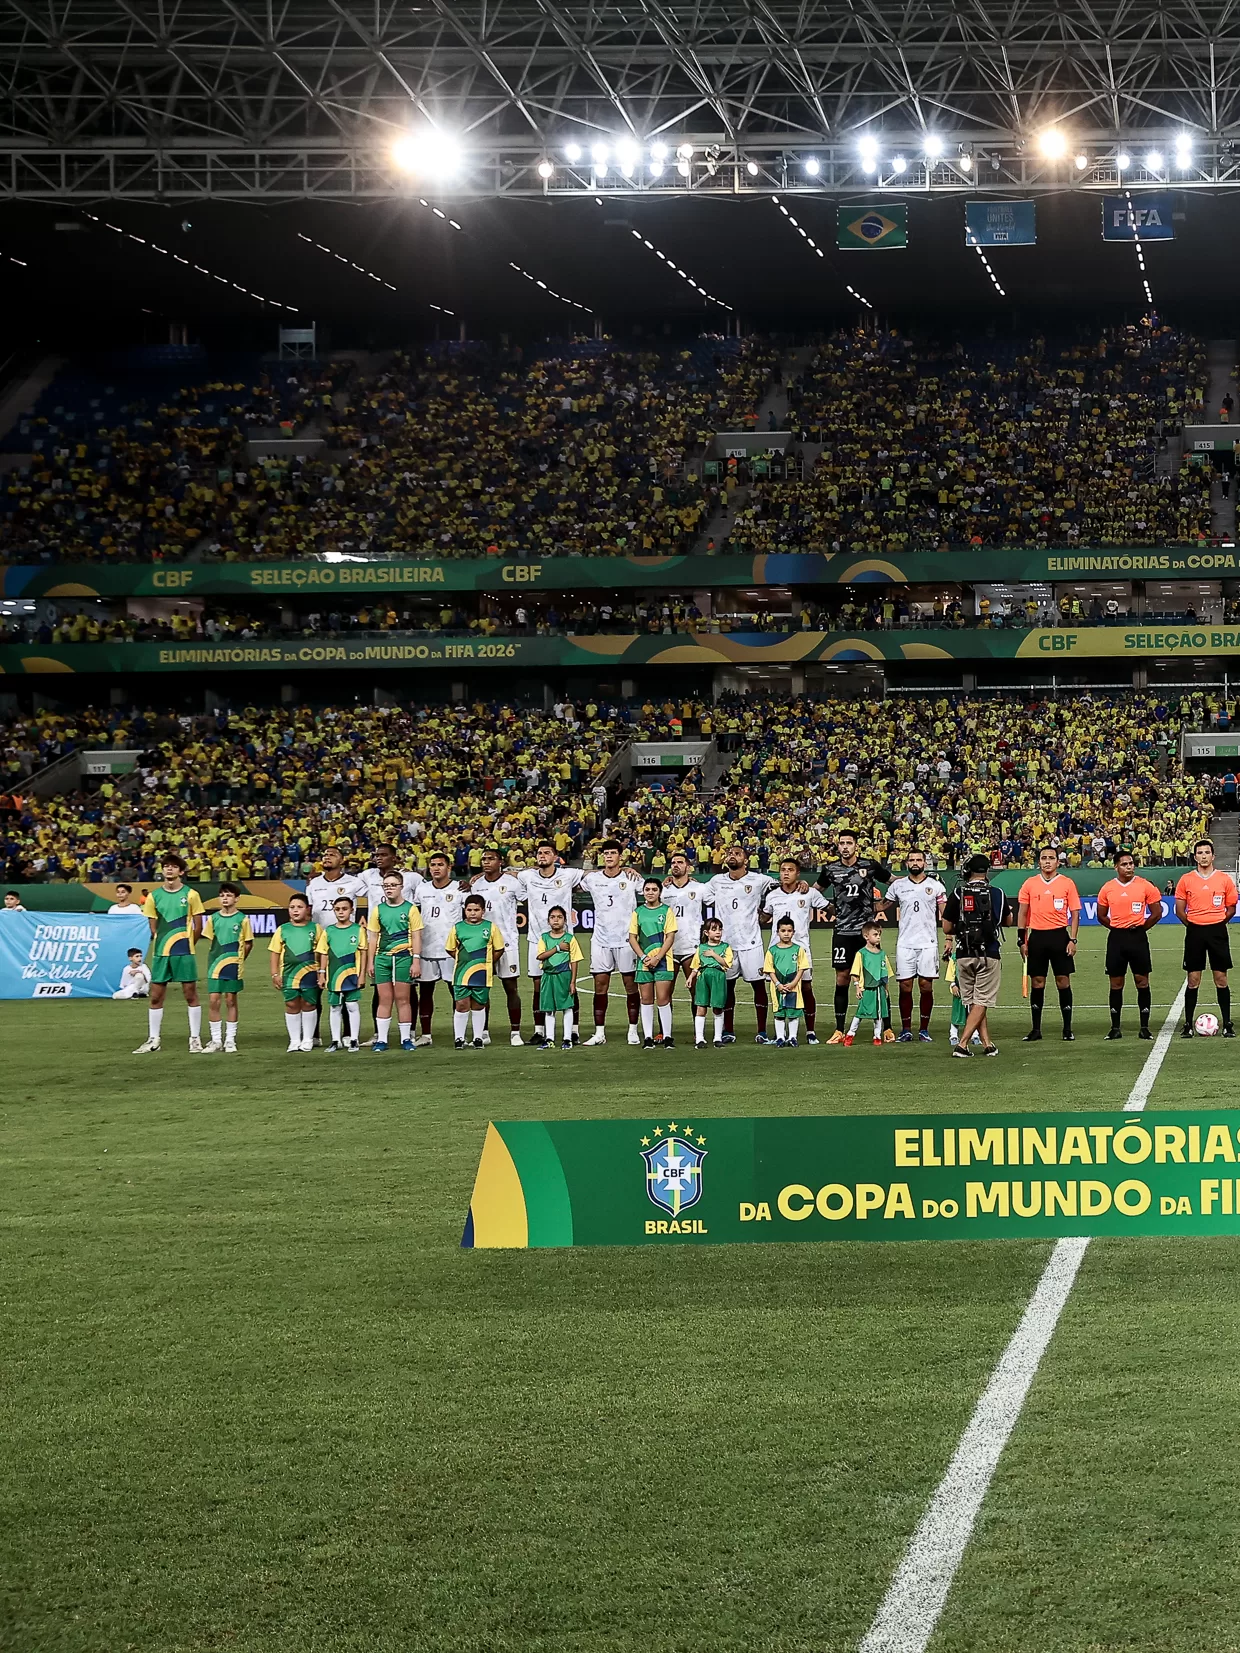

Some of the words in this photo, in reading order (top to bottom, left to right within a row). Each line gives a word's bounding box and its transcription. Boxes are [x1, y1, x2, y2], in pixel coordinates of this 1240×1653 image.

[987, 213, 1014, 222] UNITES
[1113, 209, 1162, 227] FIFA
[1047, 553, 1170, 571] ELIMINATÓRIAS
[1172, 560, 1186, 569] DA
[1187, 554, 1235, 569] COPA
[152, 570, 193, 587] CBF
[250, 566, 335, 587] SELEÇÃO
[339, 567, 444, 584] BRASILEIRA
[502, 565, 542, 582] CBF
[1038, 634, 1078, 651] CBF
[1124, 630, 1207, 651] SELEÇÃO
[159, 646, 282, 664] ELIMINATÓRIAS
[284, 653, 297, 661] DA
[299, 647, 347, 661] COPA
[350, 652, 364, 660] DO
[365, 645, 429, 660] MUNDO
[431, 651, 442, 659] DA
[445, 645, 474, 659] FIFA
[541, 893, 547, 904] 4
[845, 884, 860, 897] 22
[606, 895, 614, 907] 3
[731, 898, 739, 909] 6
[913, 900, 920, 912] 8
[430, 906, 441, 918] 19
[675, 905, 684, 918] 21
[34, 925, 101, 941] FOOTBALL
[28, 940, 100, 963] UNITES
[833, 947, 846, 960] 22
[21, 963, 47, 980] the
[48, 963, 98, 981] World
[39, 986, 66, 994] FIFA
[663, 1168, 685, 1178] CBF
[739, 1202, 772, 1221] DA
[777, 1182, 916, 1220] COPA
[922, 1199, 959, 1219] DO
[965, 1179, 1152, 1218] MUNDO
[1160, 1196, 1192, 1215] DA
[644, 1219, 708, 1235] BRASIL
